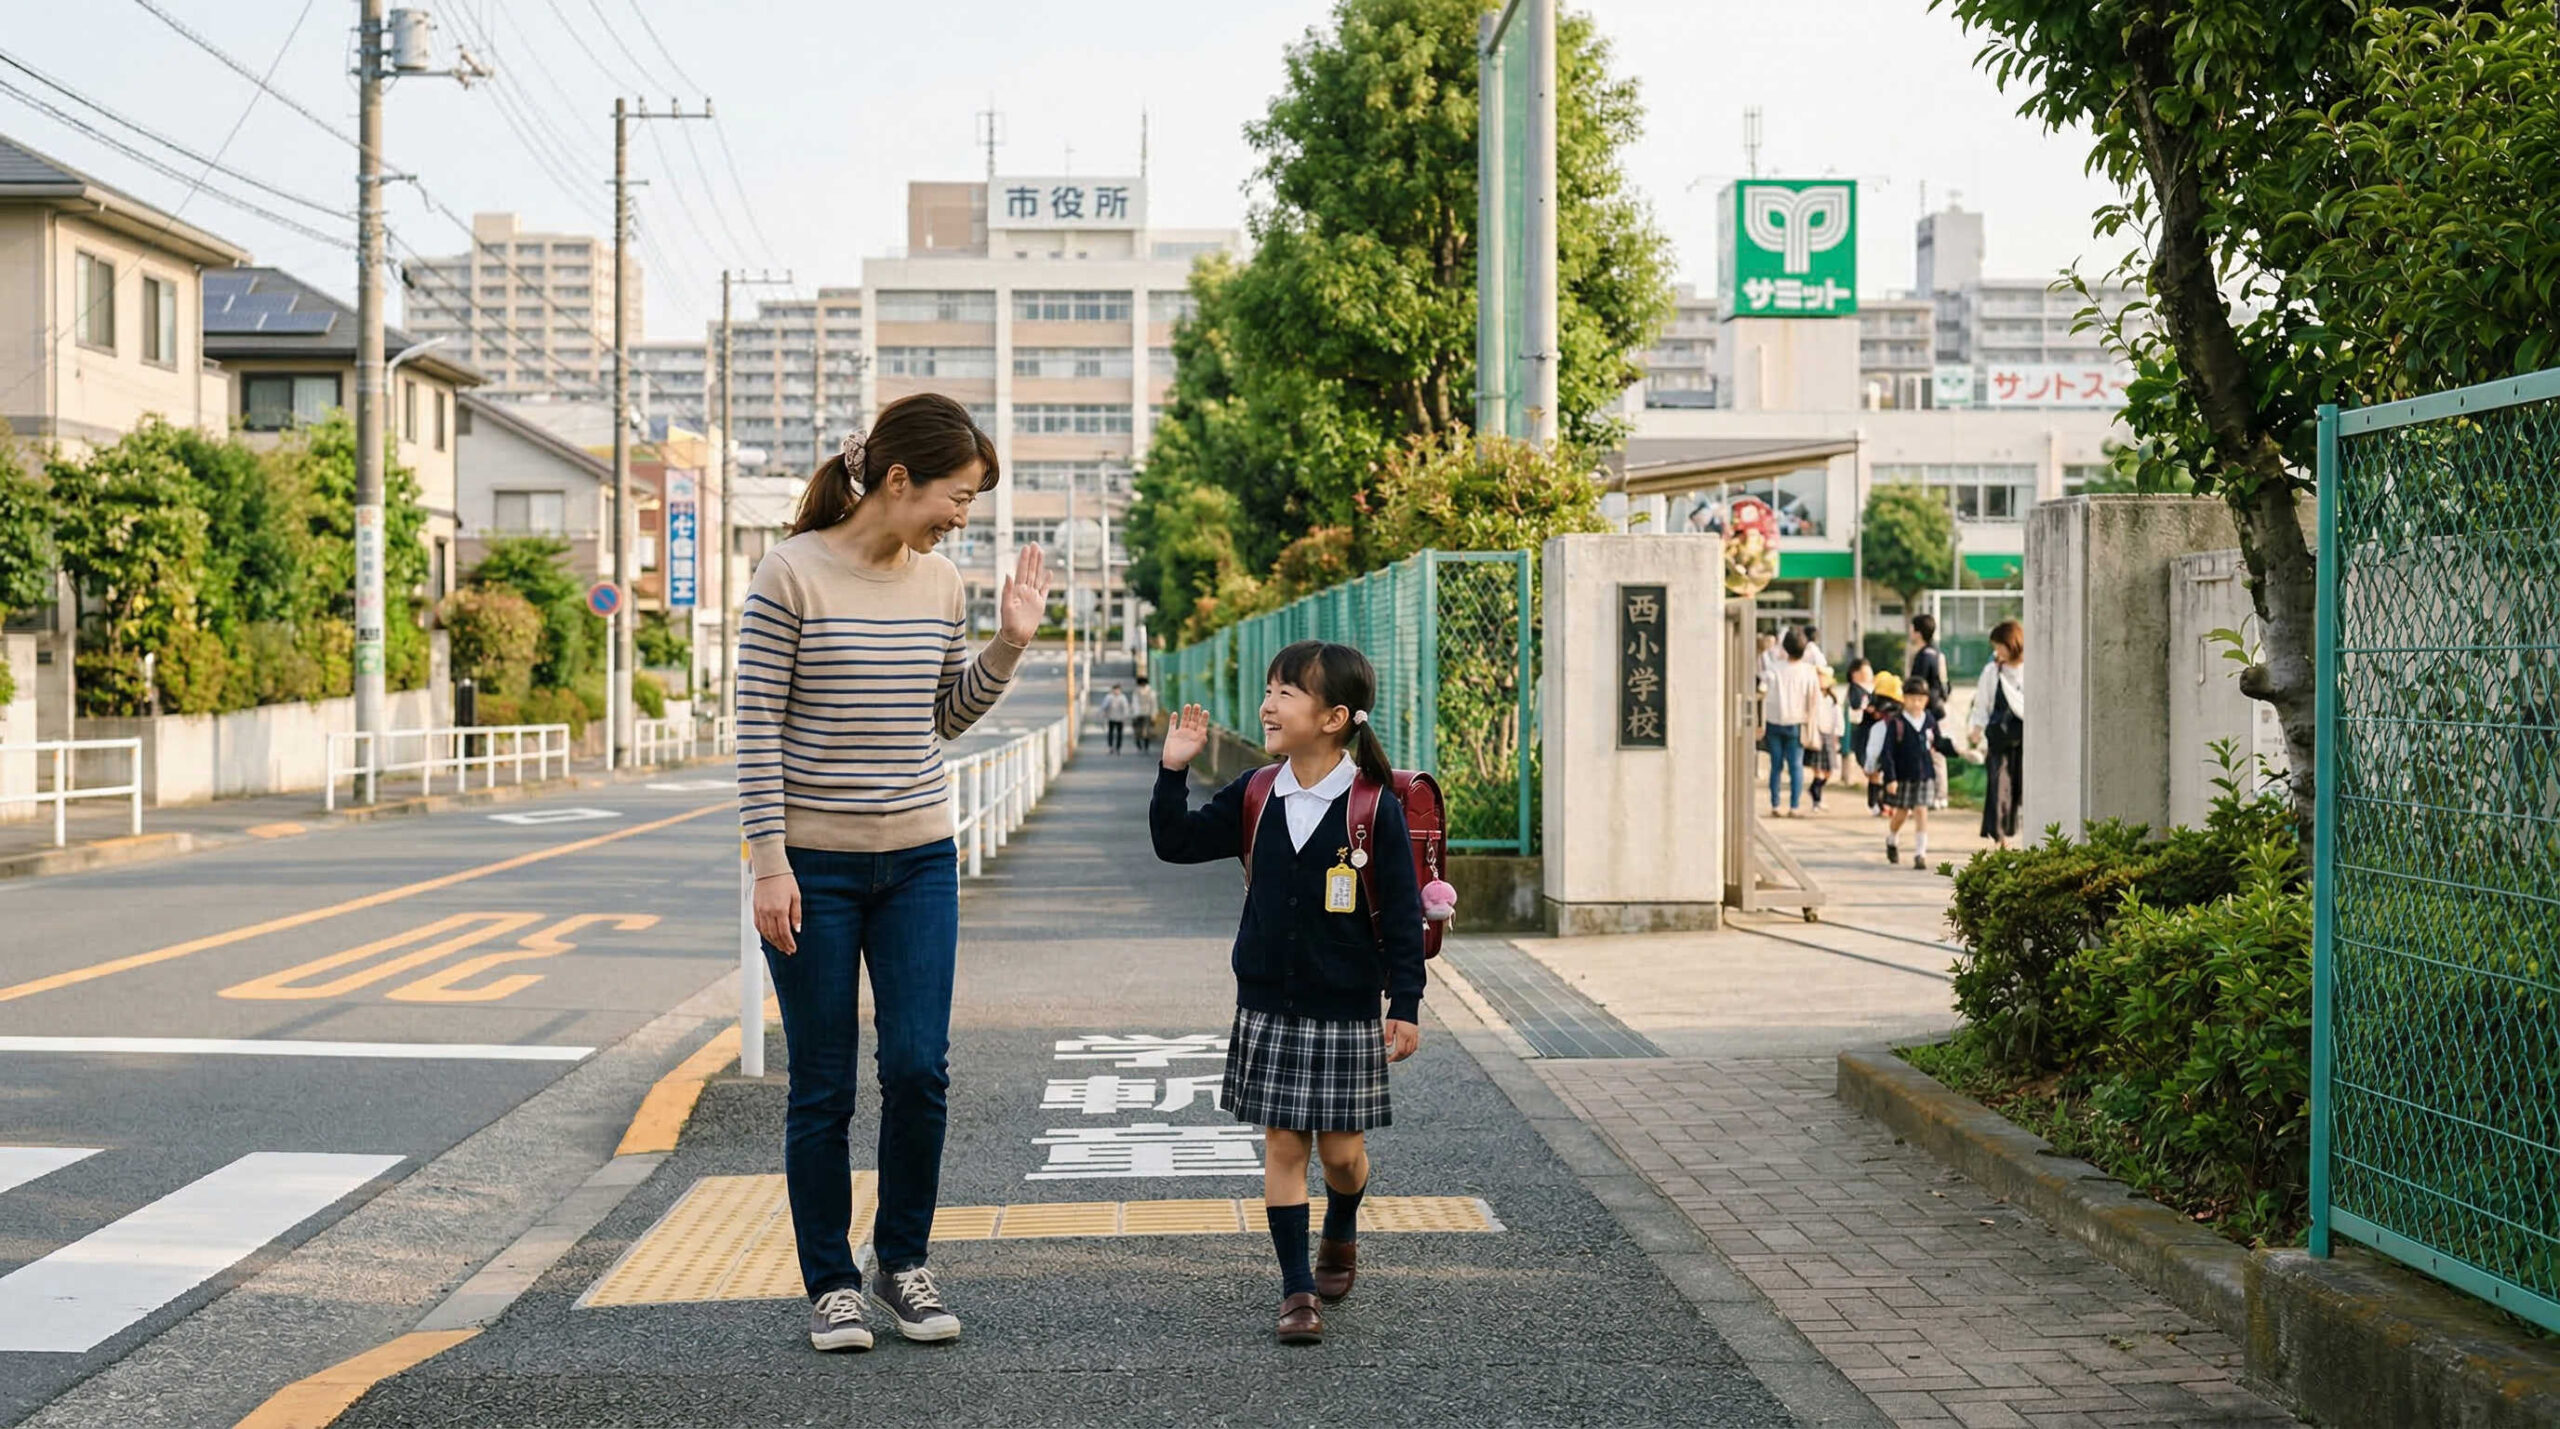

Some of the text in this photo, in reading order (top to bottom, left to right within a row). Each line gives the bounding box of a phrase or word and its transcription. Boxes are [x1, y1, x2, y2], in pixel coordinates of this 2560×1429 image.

[1005, 186, 1128, 219] 市役所
[1742, 277, 1851, 310] サミット
[1626, 595, 1661, 738] 西小学校
[217, 913, 661, 1002] 30
